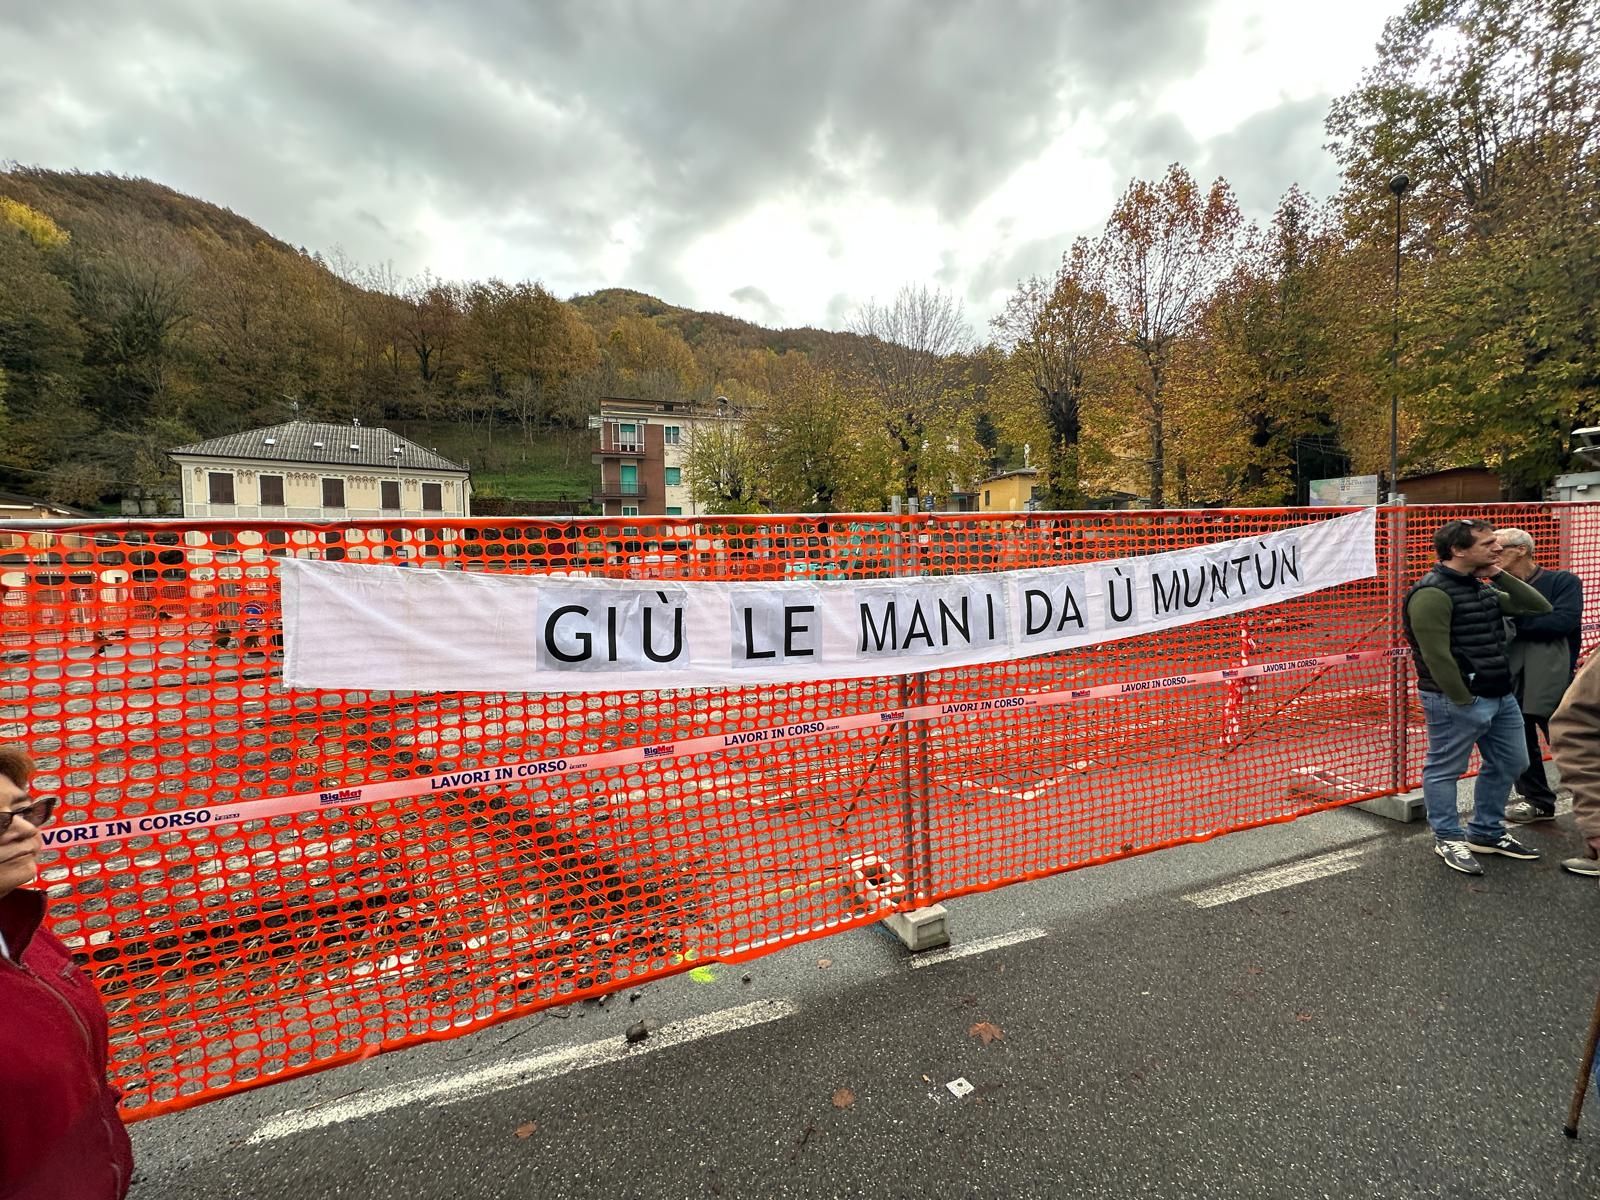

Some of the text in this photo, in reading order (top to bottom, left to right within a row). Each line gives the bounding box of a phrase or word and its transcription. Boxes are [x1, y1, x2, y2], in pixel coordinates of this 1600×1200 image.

[545, 542, 1299, 662] GIÙ LE MANI DA Ù MUNTÙN
[1262, 659, 1318, 673] LAVORI IN CORSO
[1121, 676, 1187, 693] LAVORI IN CORSO
[941, 697, 1025, 714] LAVORI IN CORSO
[724, 722, 825, 746] LAVORI IN CORSO
[643, 744, 675, 757] BigMat
[431, 759, 568, 790] LAVORI IN CORSO
[320, 789, 363, 803] BigMat
[41, 809, 212, 846] VORI IN CORSO
